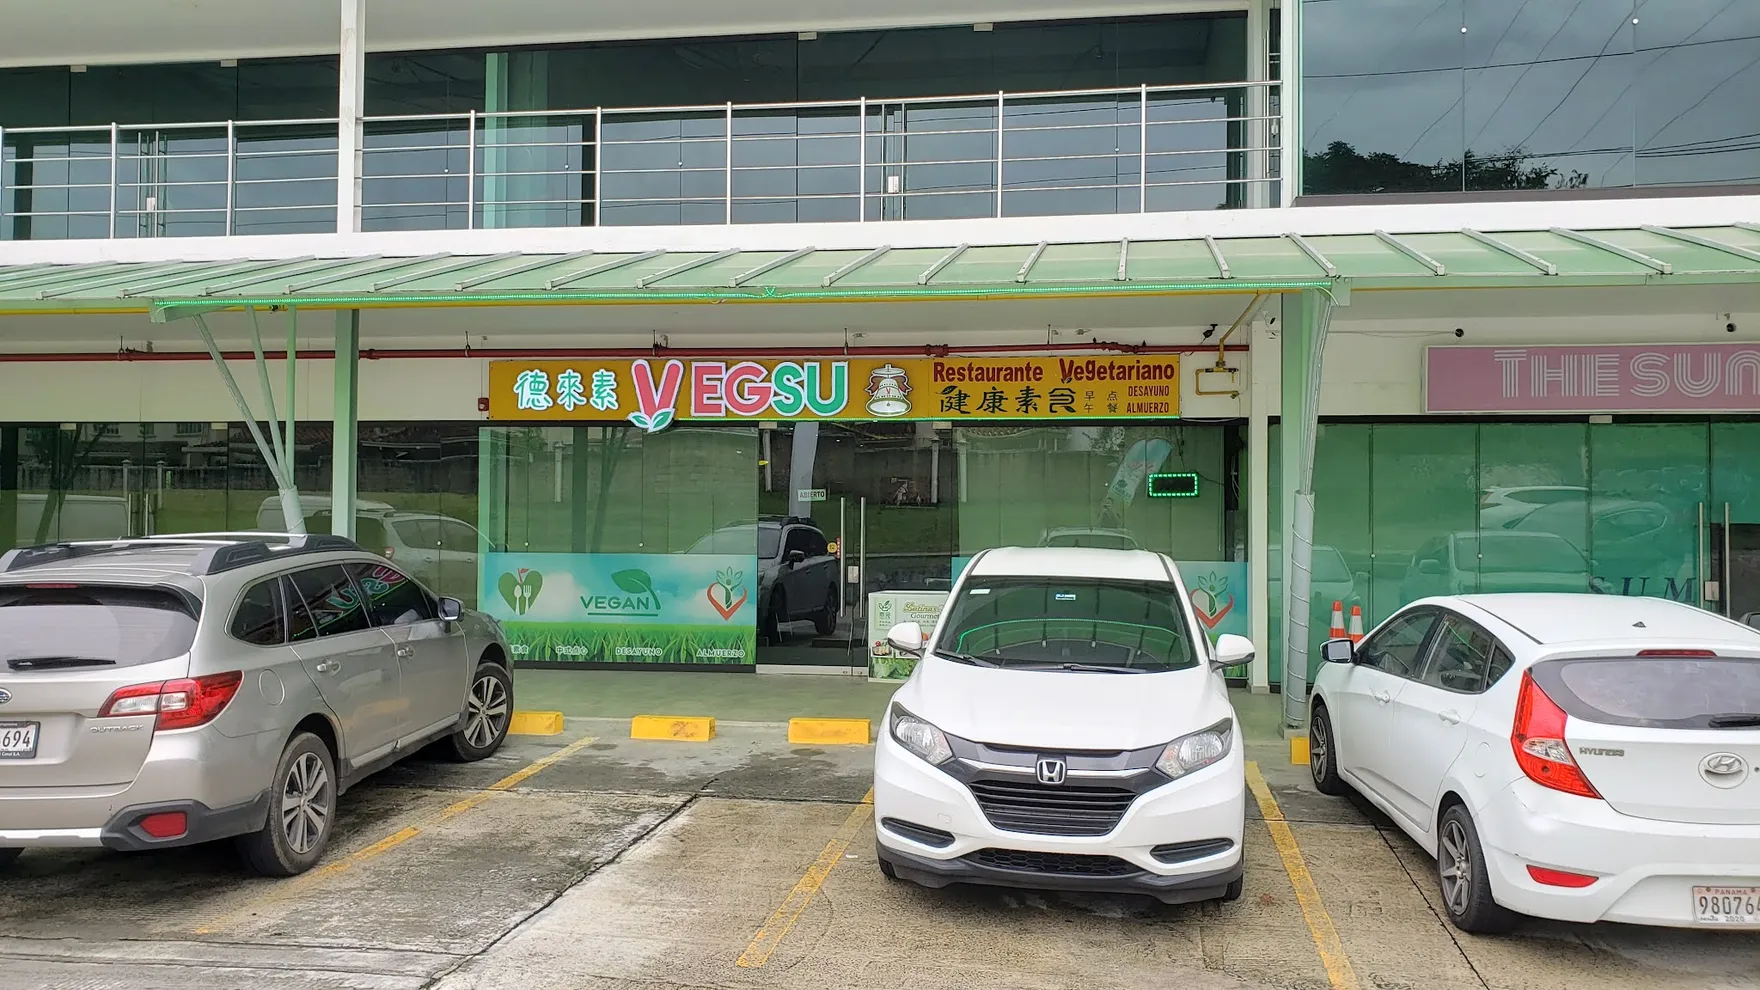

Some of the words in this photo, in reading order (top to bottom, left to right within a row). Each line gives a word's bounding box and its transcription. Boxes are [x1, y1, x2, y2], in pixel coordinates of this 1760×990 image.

[933, 361, 1043, 382] Restaurante
[1059, 358, 1175, 383] Vegetariano
[1494, 350, 1620, 398] THE
[513, 369, 619, 411] 德來素
[631, 359, 848, 426] VEGSU
[1128, 385, 1169, 396] DESAYUNO
[1126, 402, 1169, 413] ALMUERZO
[580, 595, 650, 610] VEGAN
[615, 647, 662, 656] DESAYUNO
[696, 648, 745, 657] ALMUERZO
[2, 730, 30, 747] 694
